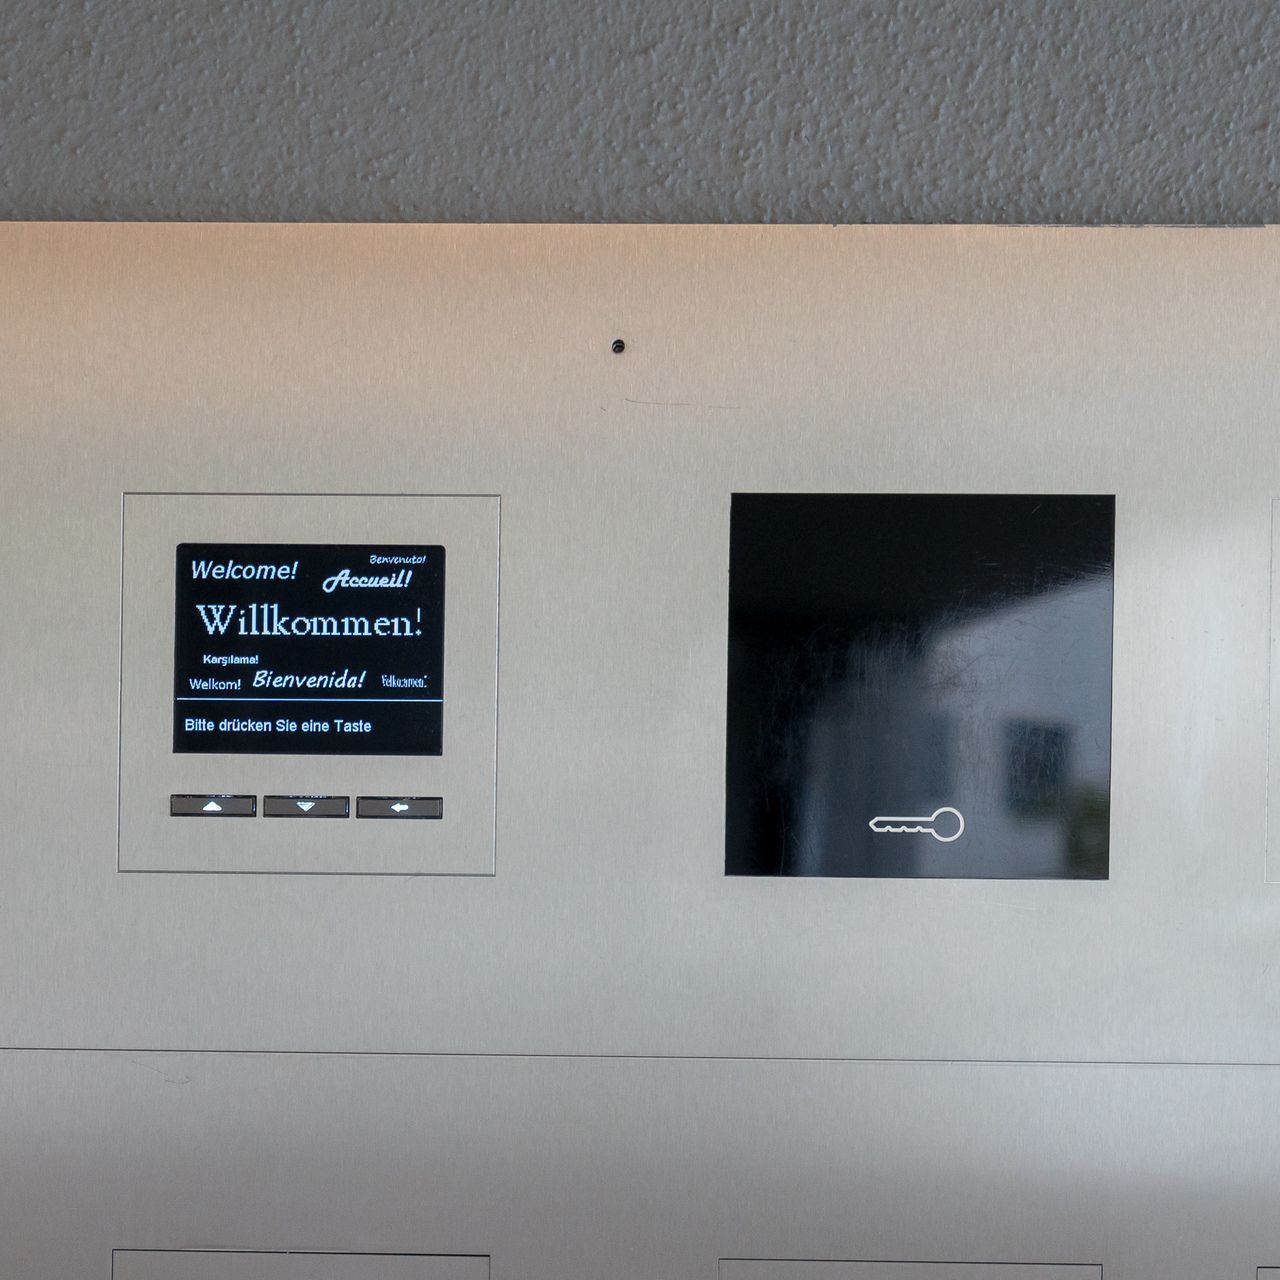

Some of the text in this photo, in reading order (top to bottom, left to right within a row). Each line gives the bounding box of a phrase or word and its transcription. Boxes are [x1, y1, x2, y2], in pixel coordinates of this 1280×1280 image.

[191, 559, 299, 580] Welcome!
[369, 554, 427, 565] Benvenuto!
[322, 568, 413, 594] Accueil!
[195, 603, 422, 637] Willkommen!
[189, 677, 241, 690] Welkom!
[252, 668, 367, 689] Bienvenida!
[184, 718, 372, 733] Bitte drücken Sie eine Taste
